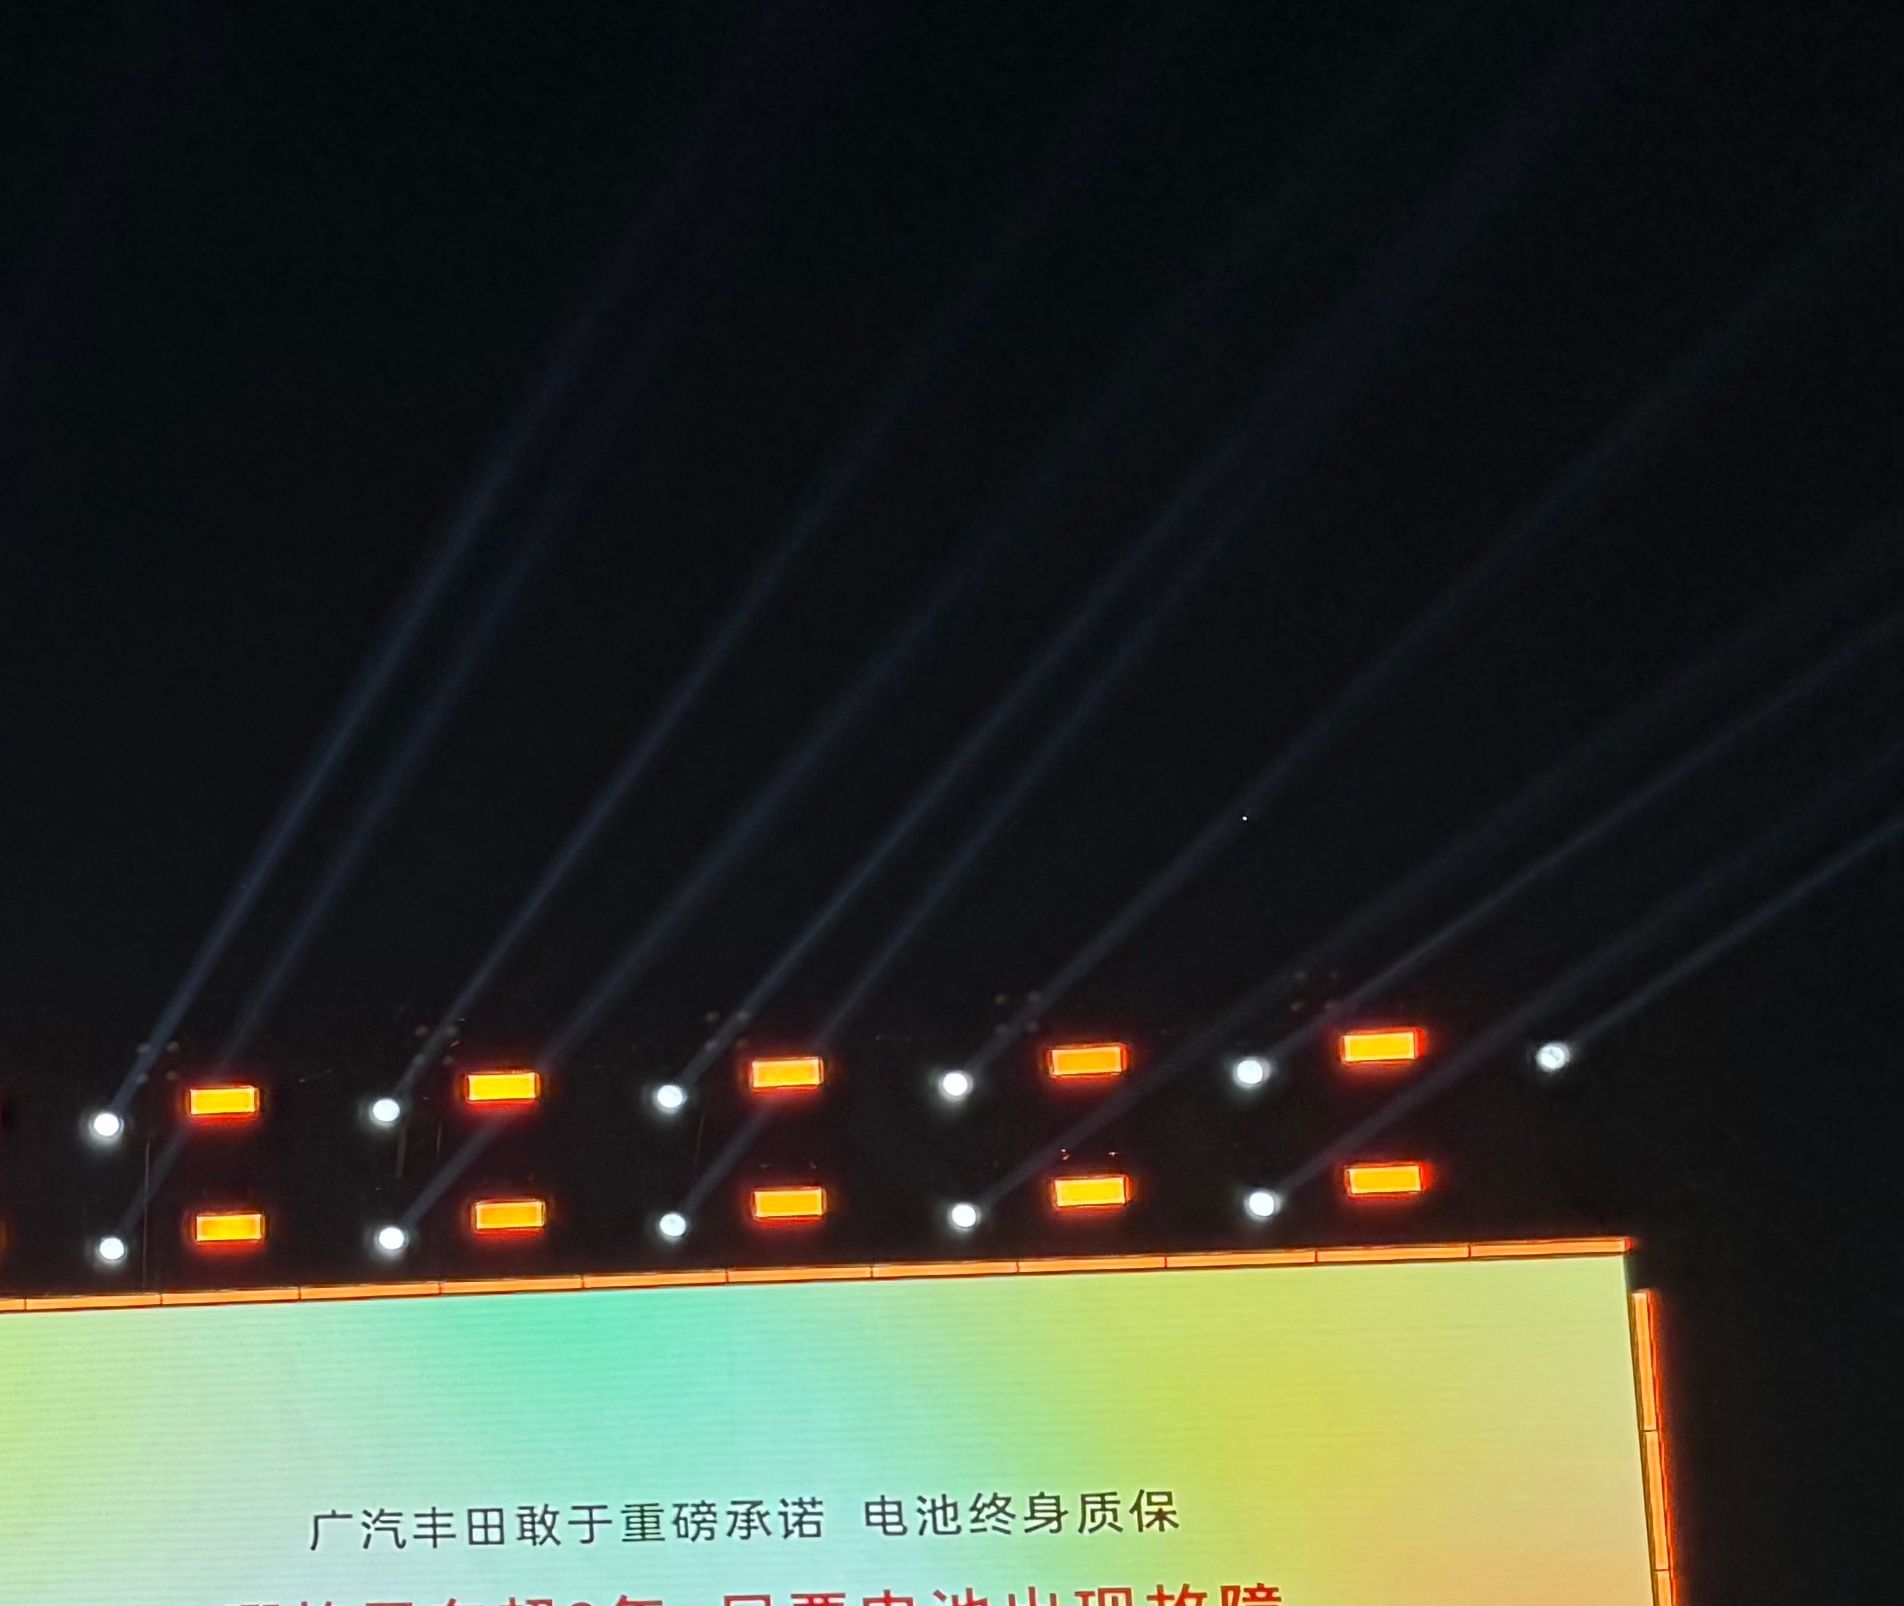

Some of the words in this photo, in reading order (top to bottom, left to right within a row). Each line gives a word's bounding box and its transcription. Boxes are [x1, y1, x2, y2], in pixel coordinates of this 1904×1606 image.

[309, 1497, 825, 1553] 广汽丰田敢于重磅承诺
[863, 1489, 1180, 1537] 电池终身质保
